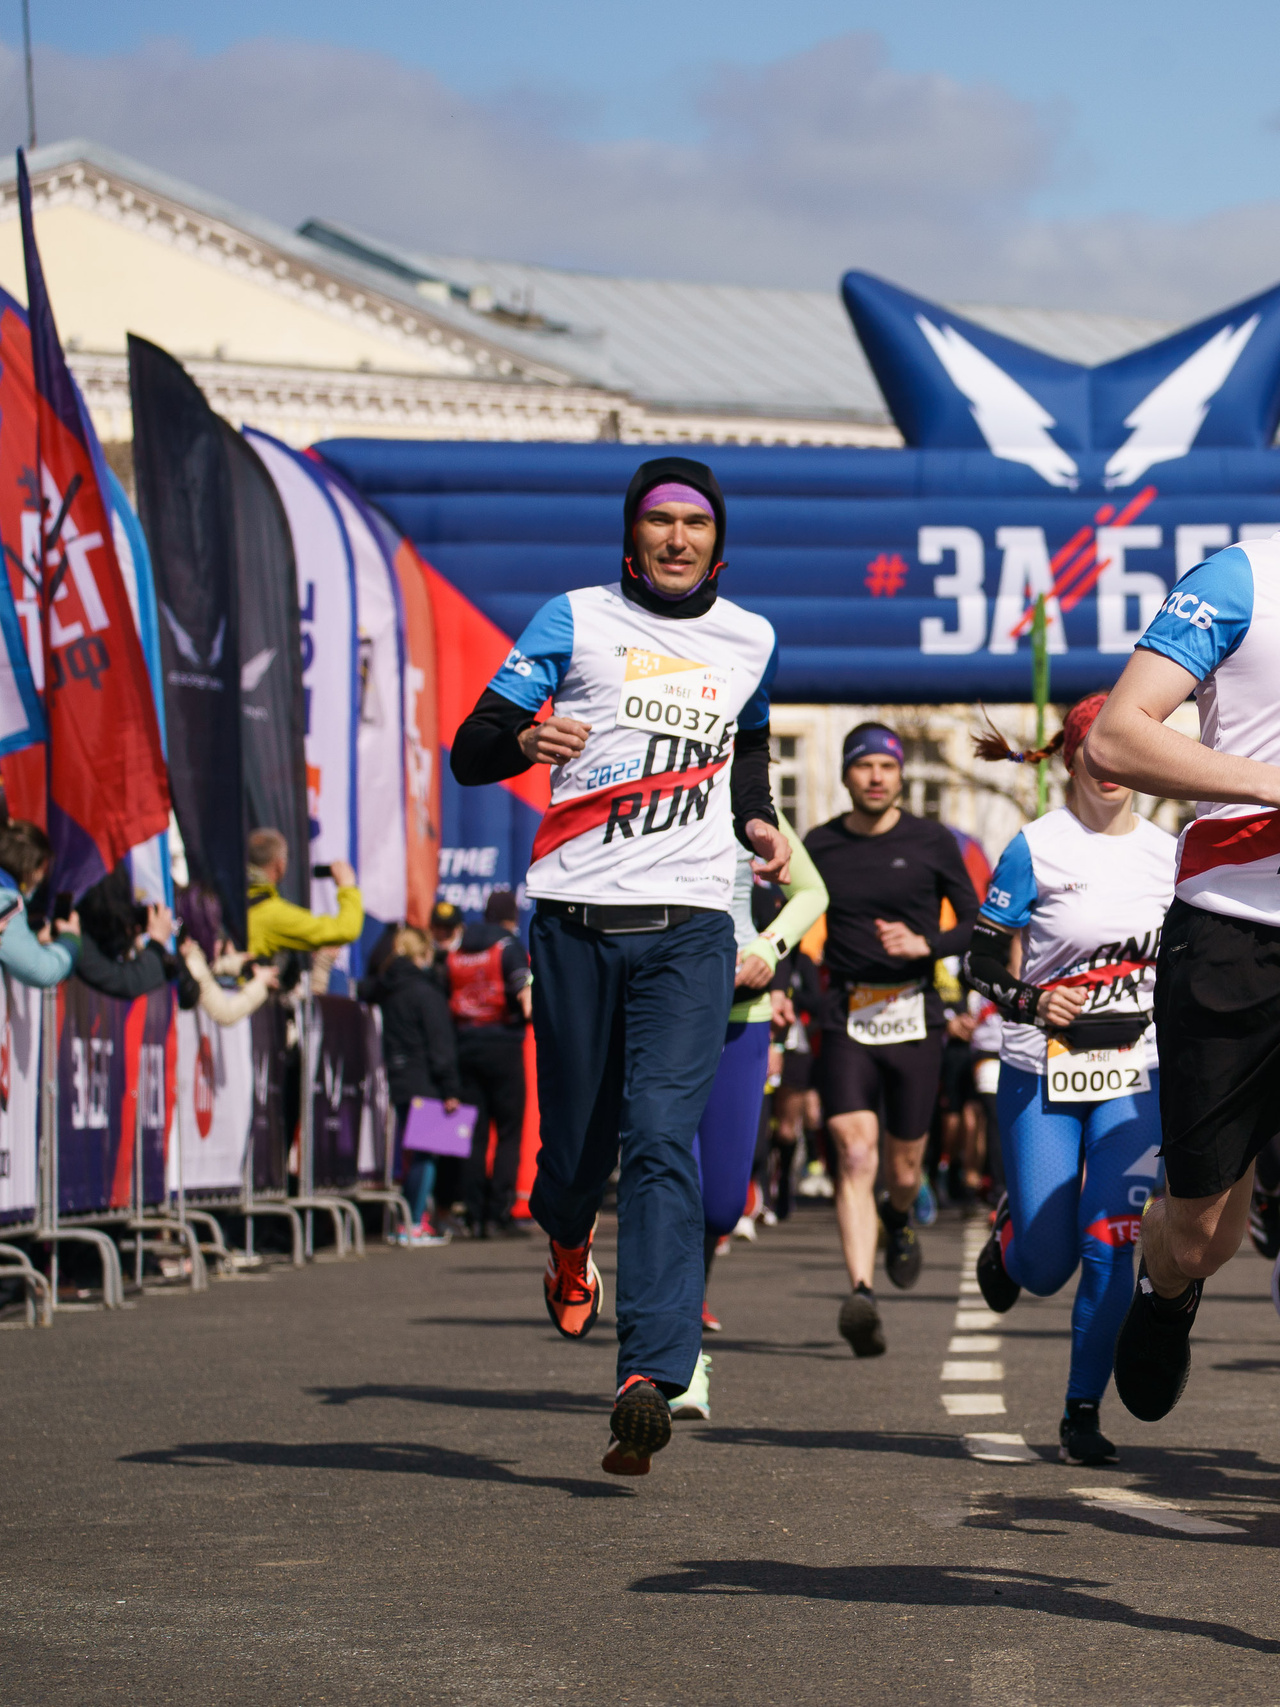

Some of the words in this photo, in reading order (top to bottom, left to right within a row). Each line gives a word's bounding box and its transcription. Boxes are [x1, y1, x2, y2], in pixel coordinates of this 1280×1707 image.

[503, 646, 536, 678] СБ
[625, 695, 721, 735] 00037
[586, 758, 641, 791] 2022
[602, 775, 714, 845] RUN
[852, 1018, 919, 1038] 00065
[1052, 1068, 1142, 1093] 00002
